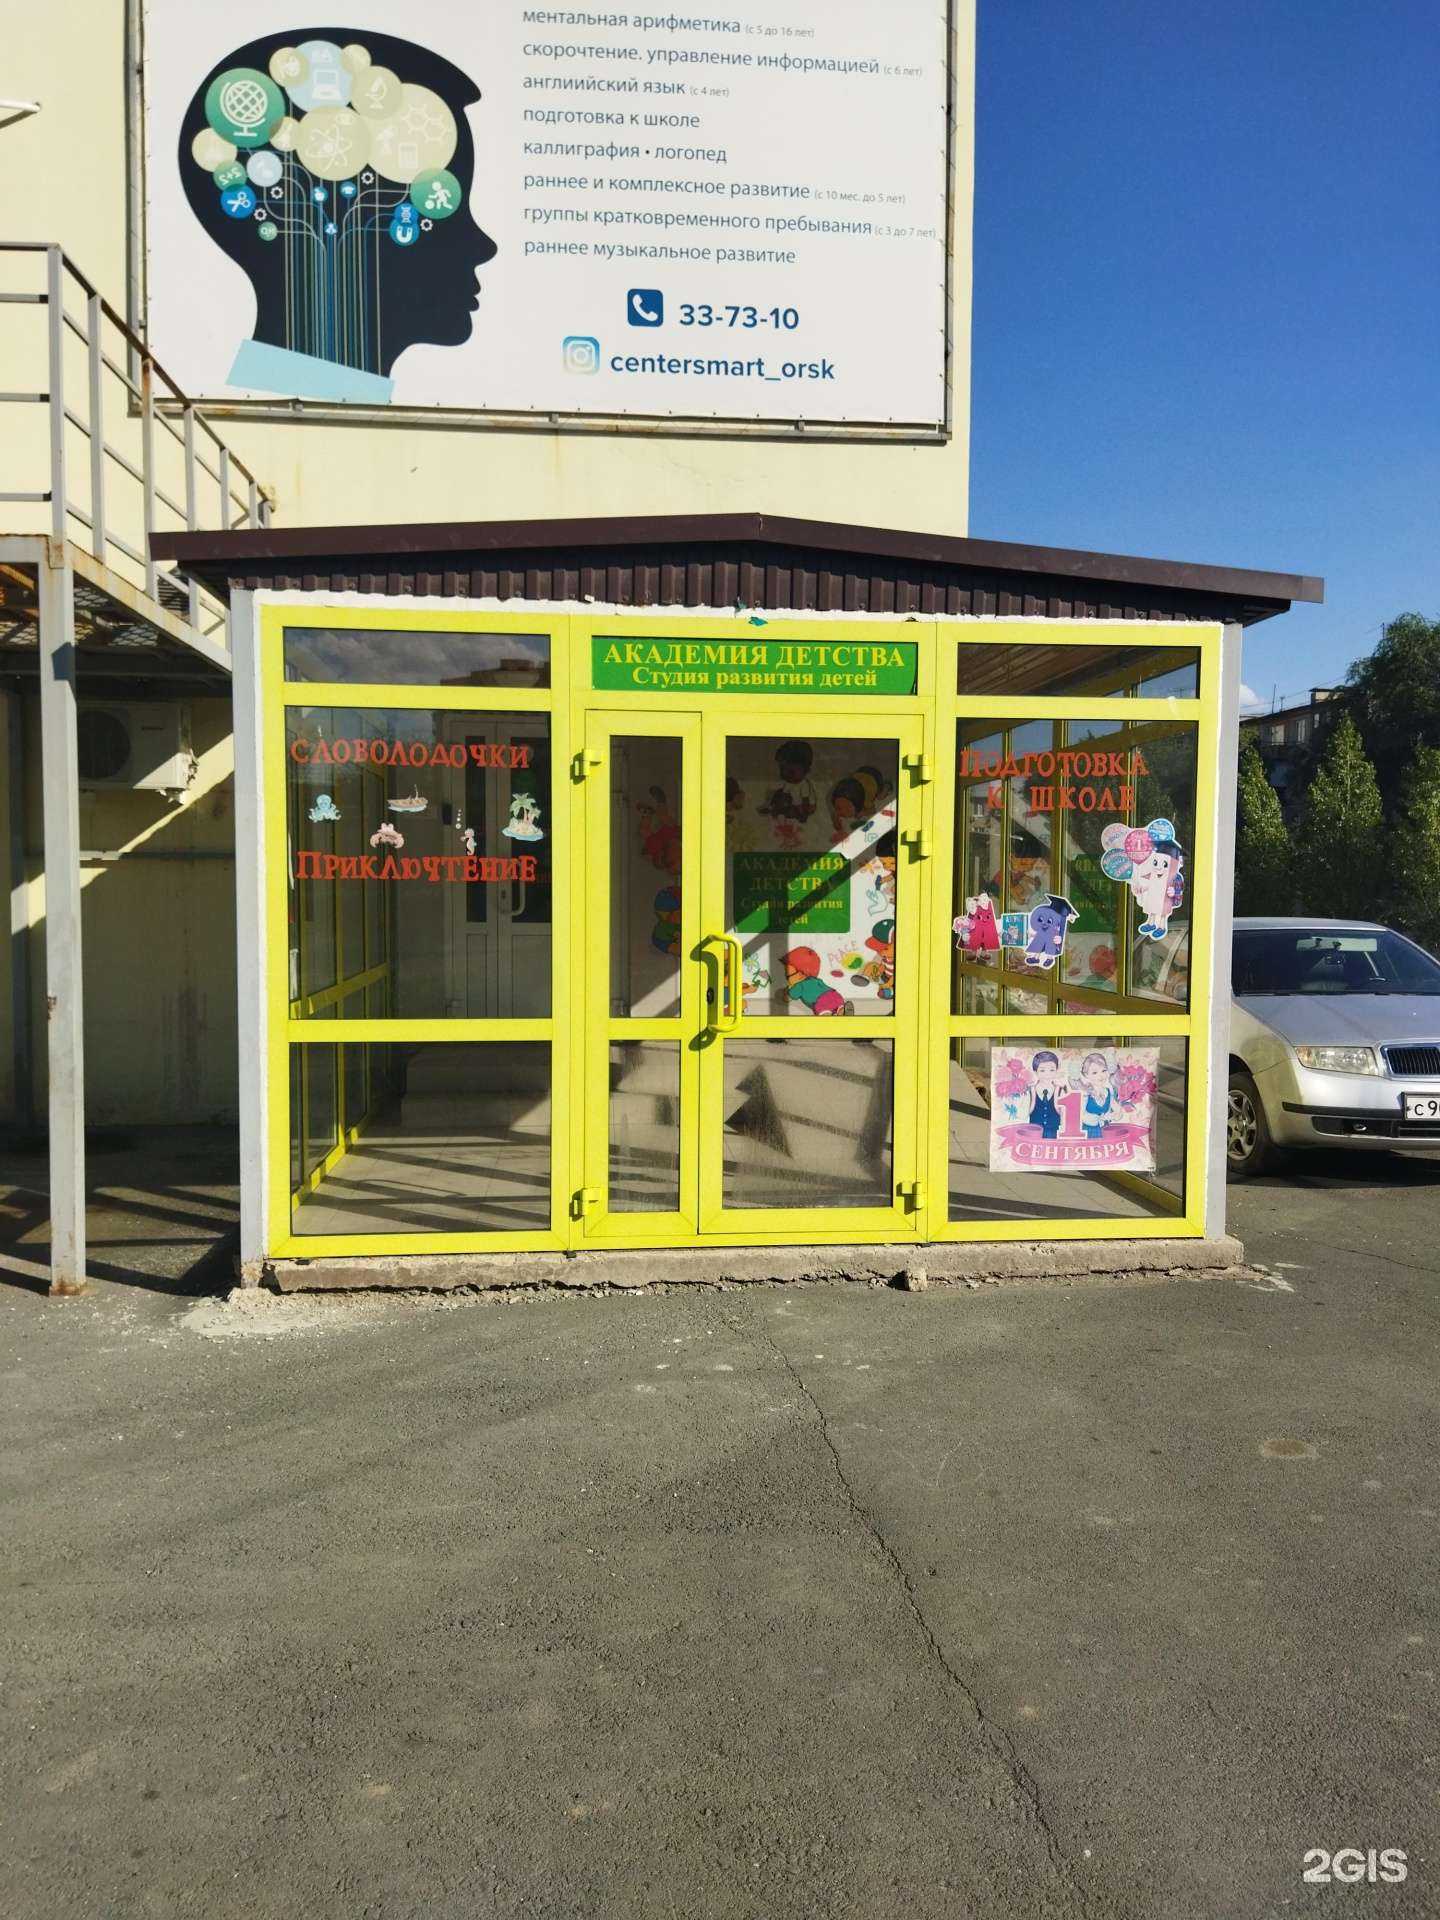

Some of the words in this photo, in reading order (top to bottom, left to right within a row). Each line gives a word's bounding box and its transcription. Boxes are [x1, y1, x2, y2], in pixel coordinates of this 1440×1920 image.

[523, 11, 628, 27] ментальная
[633, 14, 740, 33] арифметика
[756, 25, 763, 34] 5
[764, 27, 778, 37] до
[781, 27, 793, 36] 16
[794, 28, 815, 38] лет)
[523, 43, 642, 60] скорочтение.
[647, 48, 752, 66] управление
[757, 53, 880, 74] информацией
[902, 67, 923, 77] лет)
[523, 75, 638, 92] англиийский
[643, 82, 685, 94] язык
[700, 86, 707, 95] 4
[709, 87, 730, 98] лет)
[524, 109, 624, 124] подготовка
[630, 113, 639, 125] к
[644, 114, 700, 128] школе
[524, 141, 640, 160] каллиграфия
[655, 146, 728, 164] логопед
[524, 175, 588, 190] раннее
[594, 178, 604, 189] и
[609, 179, 725, 194] комплексное
[730, 182, 810, 199] развитие
[826, 190, 838, 200] 10
[840, 191, 859, 201] мес.
[862, 193, 876, 203] до
[877, 193, 884, 203] 5
[885, 194, 906, 205] лет)
[524, 208, 588, 224] группы
[594, 210, 760, 229] кратковременного
[765, 215, 872, 234] пребывания
[885, 226, 891, 236] 3
[894, 228, 906, 237] до
[908, 227, 915, 236] 7
[916, 228, 936, 239] лет)
[524, 241, 589, 256] раннее
[594, 243, 711, 260] музыкальное
[716, 247, 796, 264] развитие
[679, 304, 799, 330] 33-73-10
[611, 354, 835, 382] centersmart_orsk
[605, 643, 768, 669] АКАДЕМИЯ
[776, 646, 905, 670] ДЕТСТВА
[632, 667, 709, 689] Студия
[716, 670, 814, 689] развития
[820, 669, 877, 687] детей
[290, 736, 531, 769] СЛОВОЛОДОЧКИ
[959, 750, 1149, 779] ПОДГОТОВКА
[987, 783, 1006, 810] К
[1029, 785, 1136, 813] ШКОЛЕ
[1056, 1089, 1088, 1140] 1
[1414, 1100, 1440, 1117] С9
[1015, 1141, 1130, 1161] СЕНТЯБРЯ
